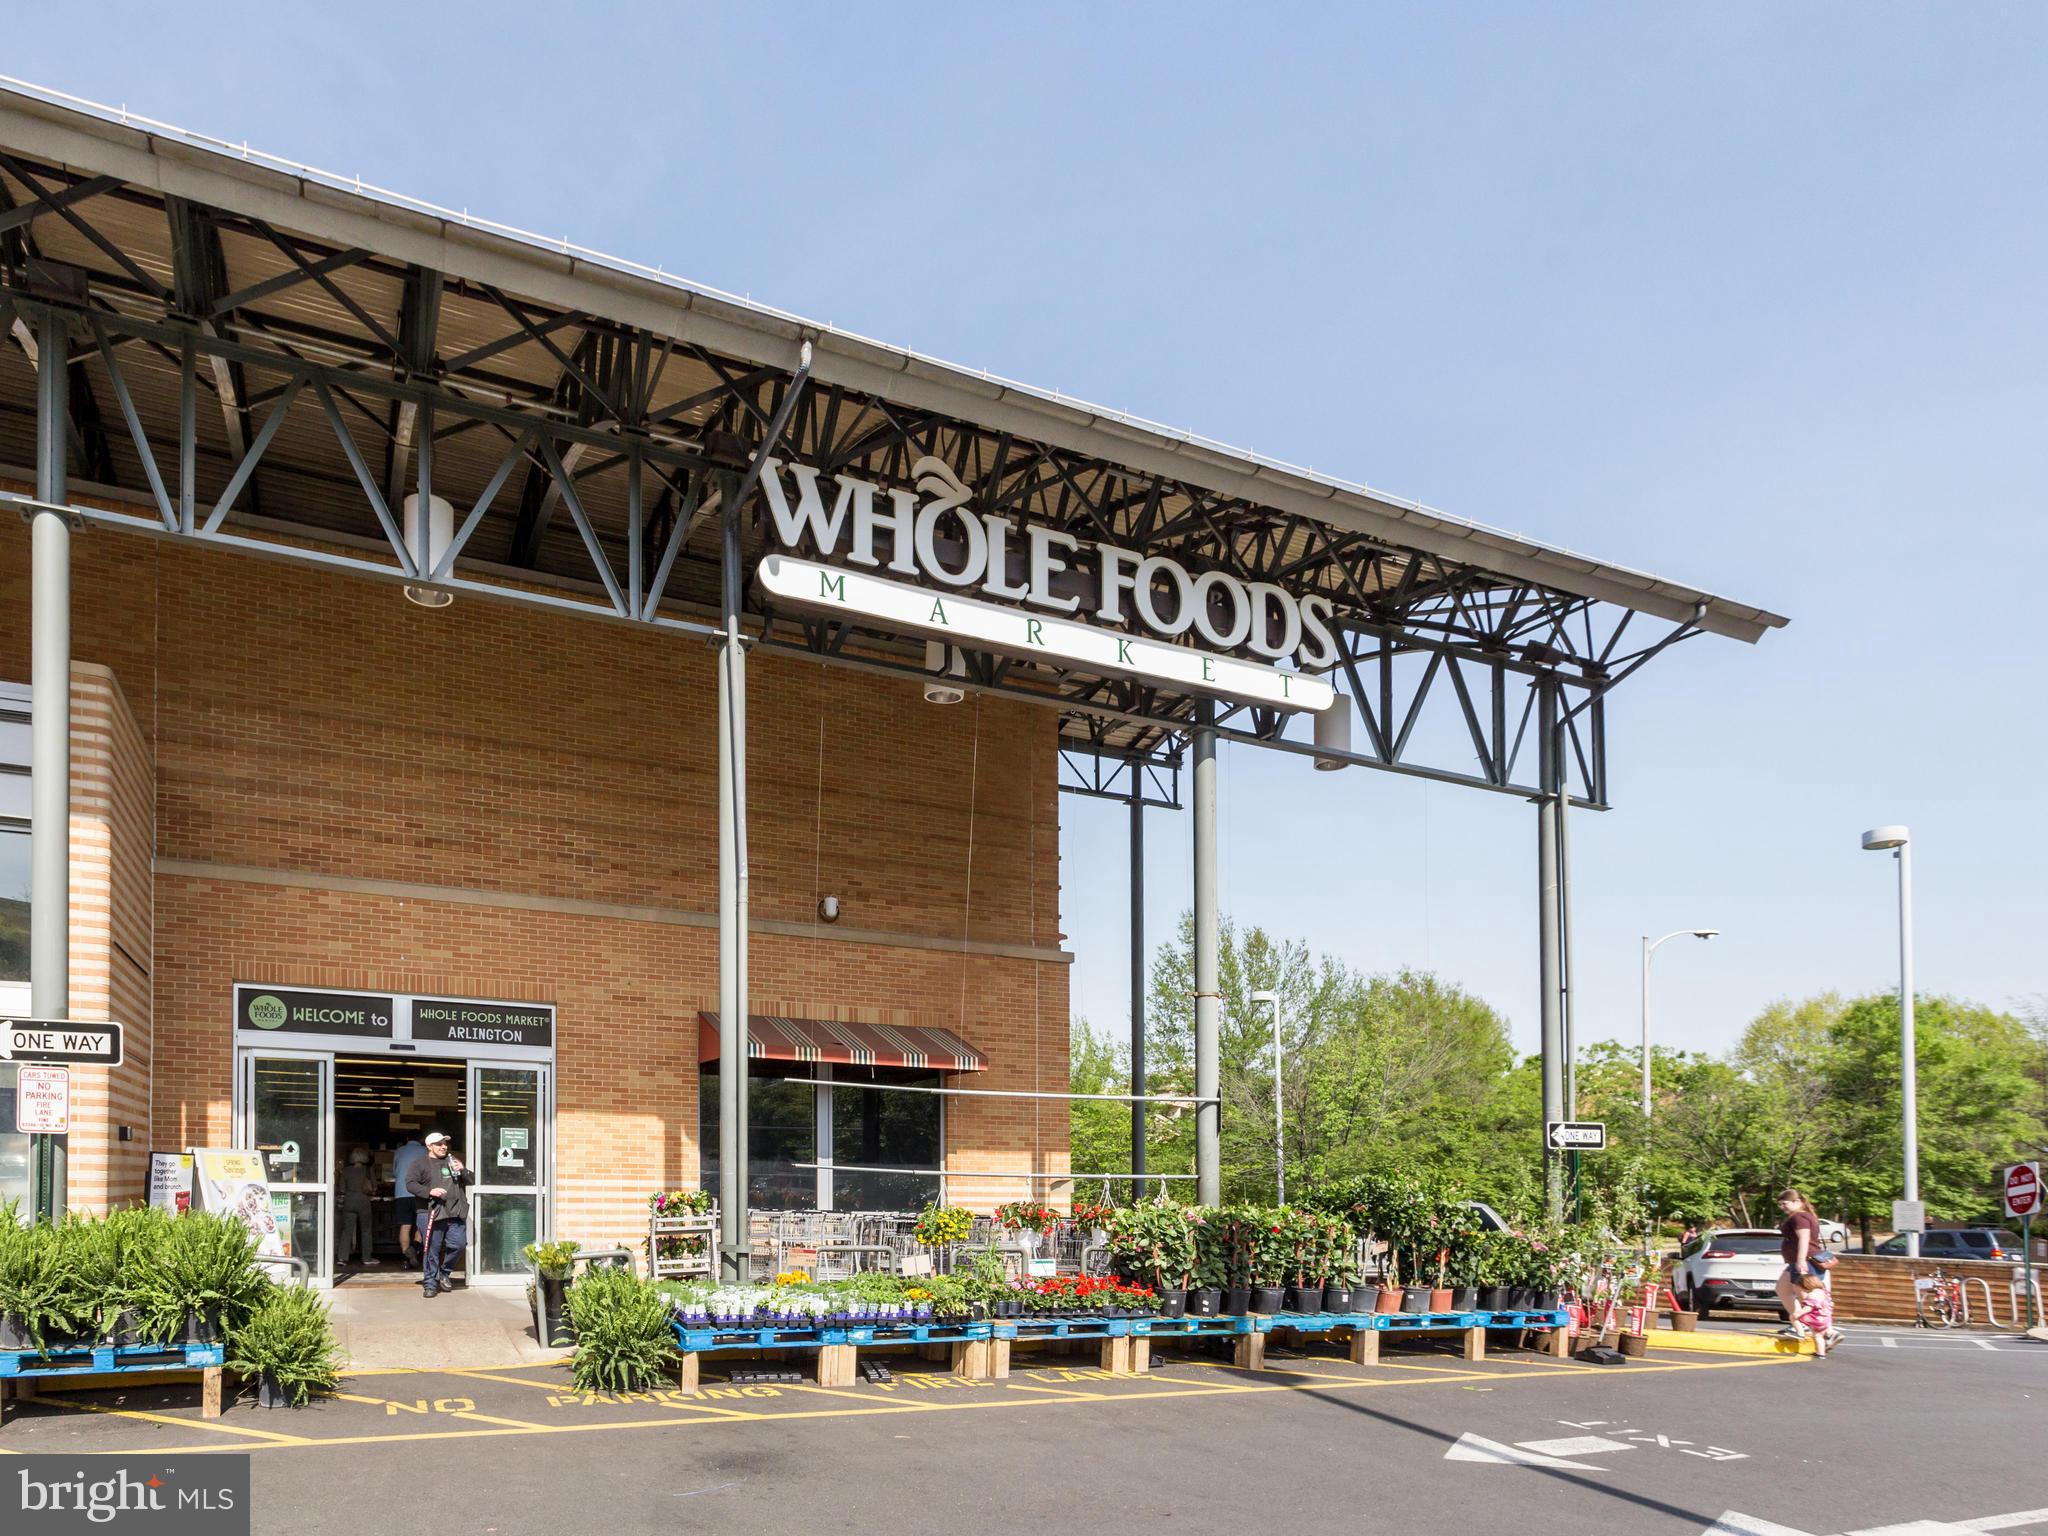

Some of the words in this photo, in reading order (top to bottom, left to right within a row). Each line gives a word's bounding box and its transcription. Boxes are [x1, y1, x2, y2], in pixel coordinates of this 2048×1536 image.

[748, 452, 1081, 612] WHOLE
[1097, 543, 1336, 668] FOODS
[818, 570, 1294, 698] MARKET
[253, 1002, 285, 1013] WHOLE
[255, 1011, 283, 1019] FOODS
[292, 1007, 366, 1025] WELCOME
[370, 1012, 388, 1026] to
[420, 1008, 458, 1021] WHOLE
[461, 1011, 502, 1024] FOODS
[447, 1026, 522, 1042] ARLINGTON
[13, 1032, 54, 1049] ONE
[62, 1034, 104, 1051] WAY
[37, 1082, 51, 1090] NO
[25, 1091, 63, 1100] PARKING
[36, 1101, 51, 1109] FIRE
[1565, 1130, 1580, 1141] ONE
[1582, 1131, 1598, 1140] WAY
[154, 1159, 168, 1168] They
[154, 1168, 177, 1176] together
[386, 1398, 476, 1416] NO
